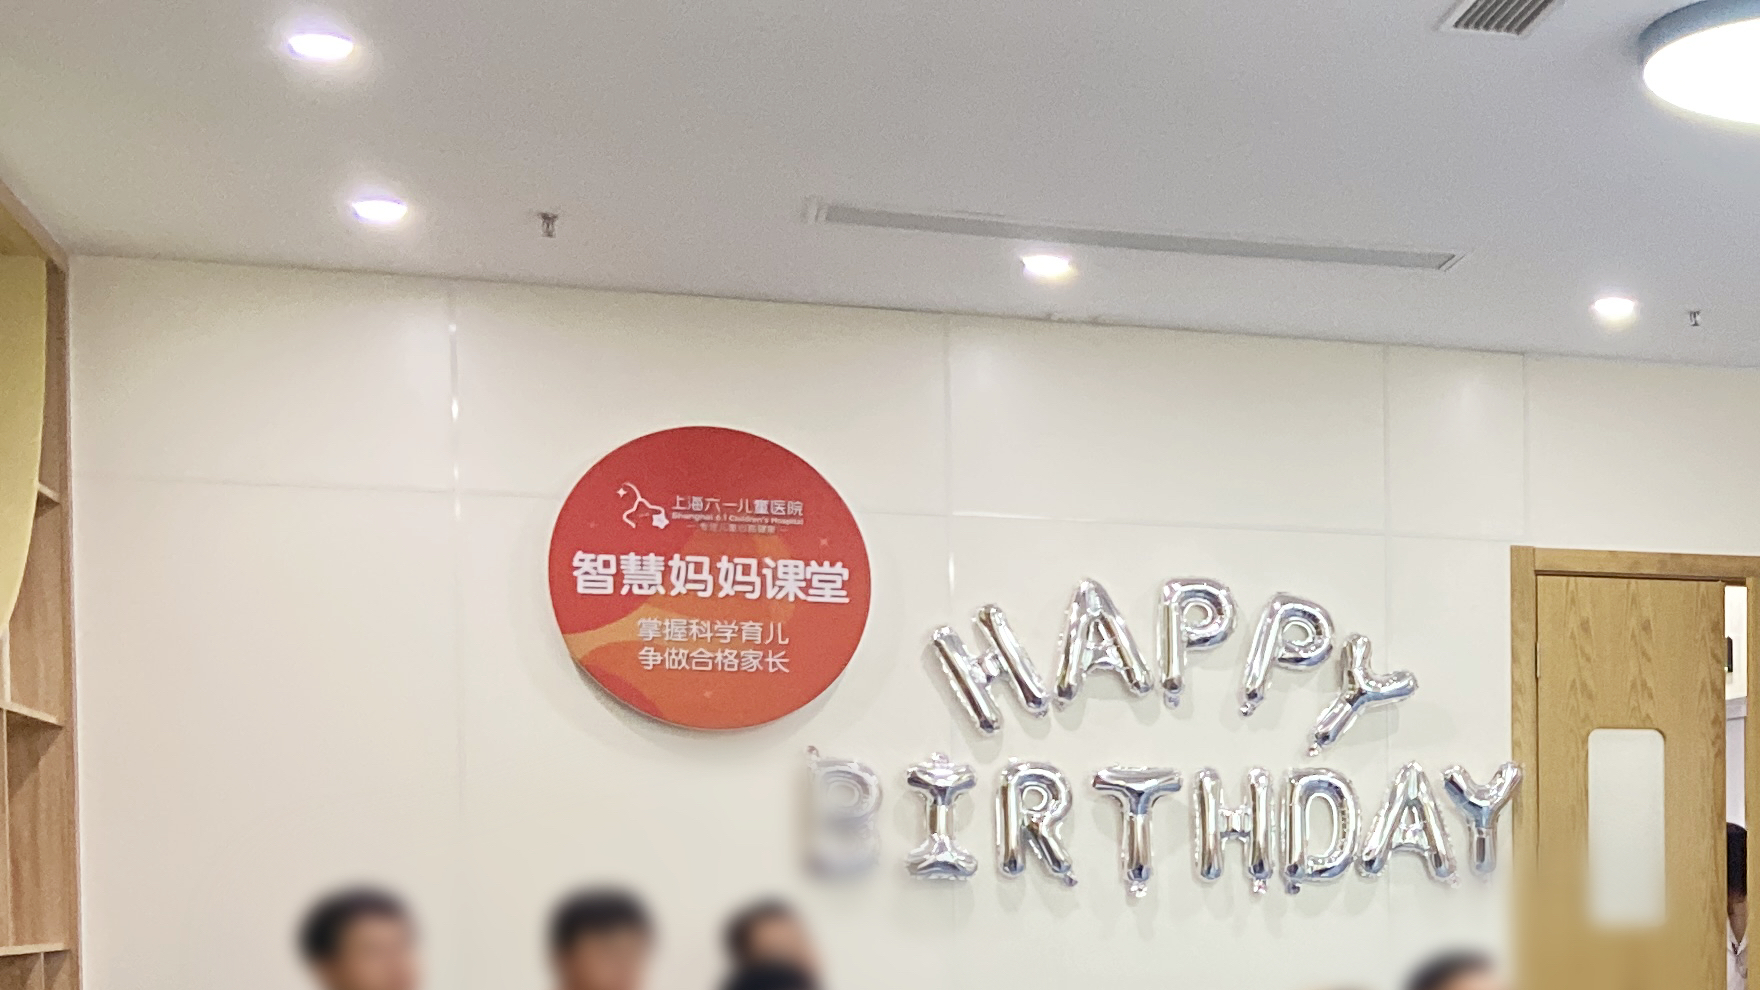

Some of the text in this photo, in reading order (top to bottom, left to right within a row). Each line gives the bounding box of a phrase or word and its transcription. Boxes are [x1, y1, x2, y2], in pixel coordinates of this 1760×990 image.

[671, 495, 804, 516] 上海六一儿童医院
[571, 549, 850, 604] 智慧妈妈课堂
[637, 617, 790, 645] 掌握科学育儿
[638, 647, 790, 673] 争做合格家长
[926, 576, 1419, 757] HAPPY
